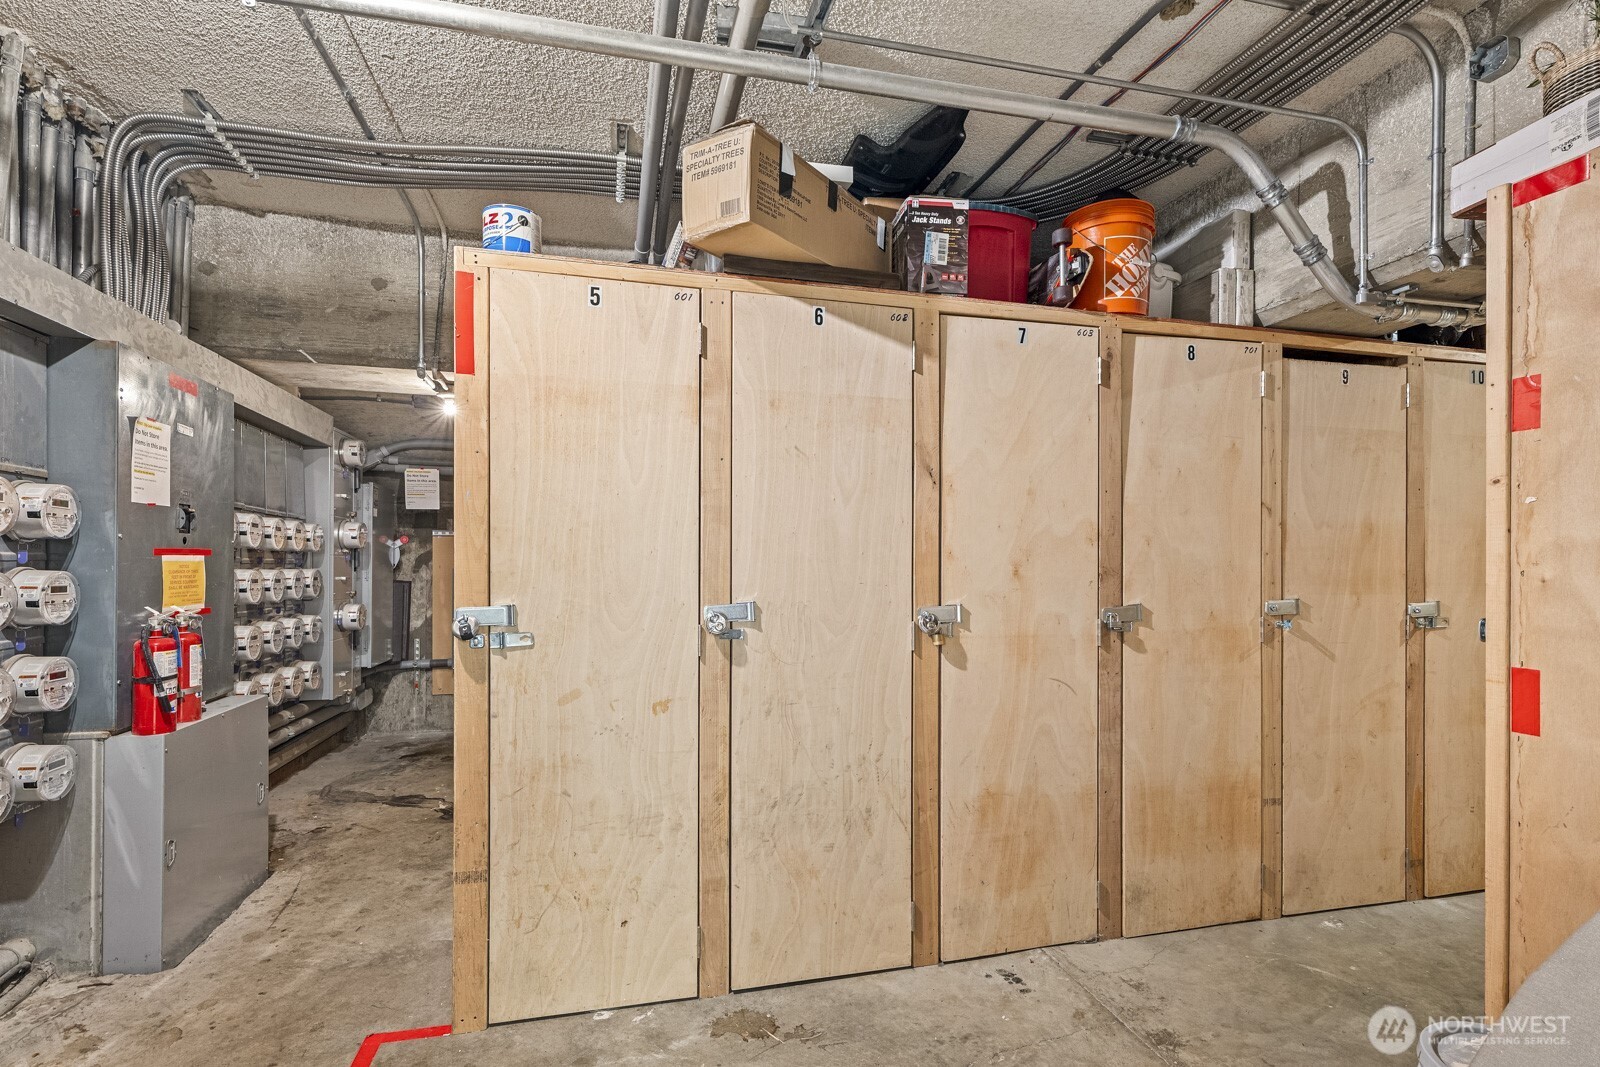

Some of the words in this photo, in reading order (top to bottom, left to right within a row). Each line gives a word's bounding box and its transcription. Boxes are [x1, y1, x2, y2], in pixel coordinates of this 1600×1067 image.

[690, 140, 732, 160] TRIM-A-TREE
[734, 138, 741, 146] U:
[686, 154, 720, 173] SPECIALTY
[722, 147, 744, 160] TREES
[691, 168, 710, 182] ITEM#
[710, 160, 736, 176] 5969181
[858, 209, 878, 230] SPECIALT
[929, 216, 952, 224] Stands
[1112, 242, 1138, 268] THE
[590, 286, 600, 306] 5
[674, 292, 693, 301] 601
[814, 308, 824, 326] 6
[1018, 328, 1026, 344] 7
[1077, 328, 1094, 337] 603
[1188, 345, 1195, 360] 8
[1342, 370, 1349, 384] 9
[1471, 370, 1484, 384] 10
[135, 438, 146, 447] Items
[149, 432, 160, 440] Store
